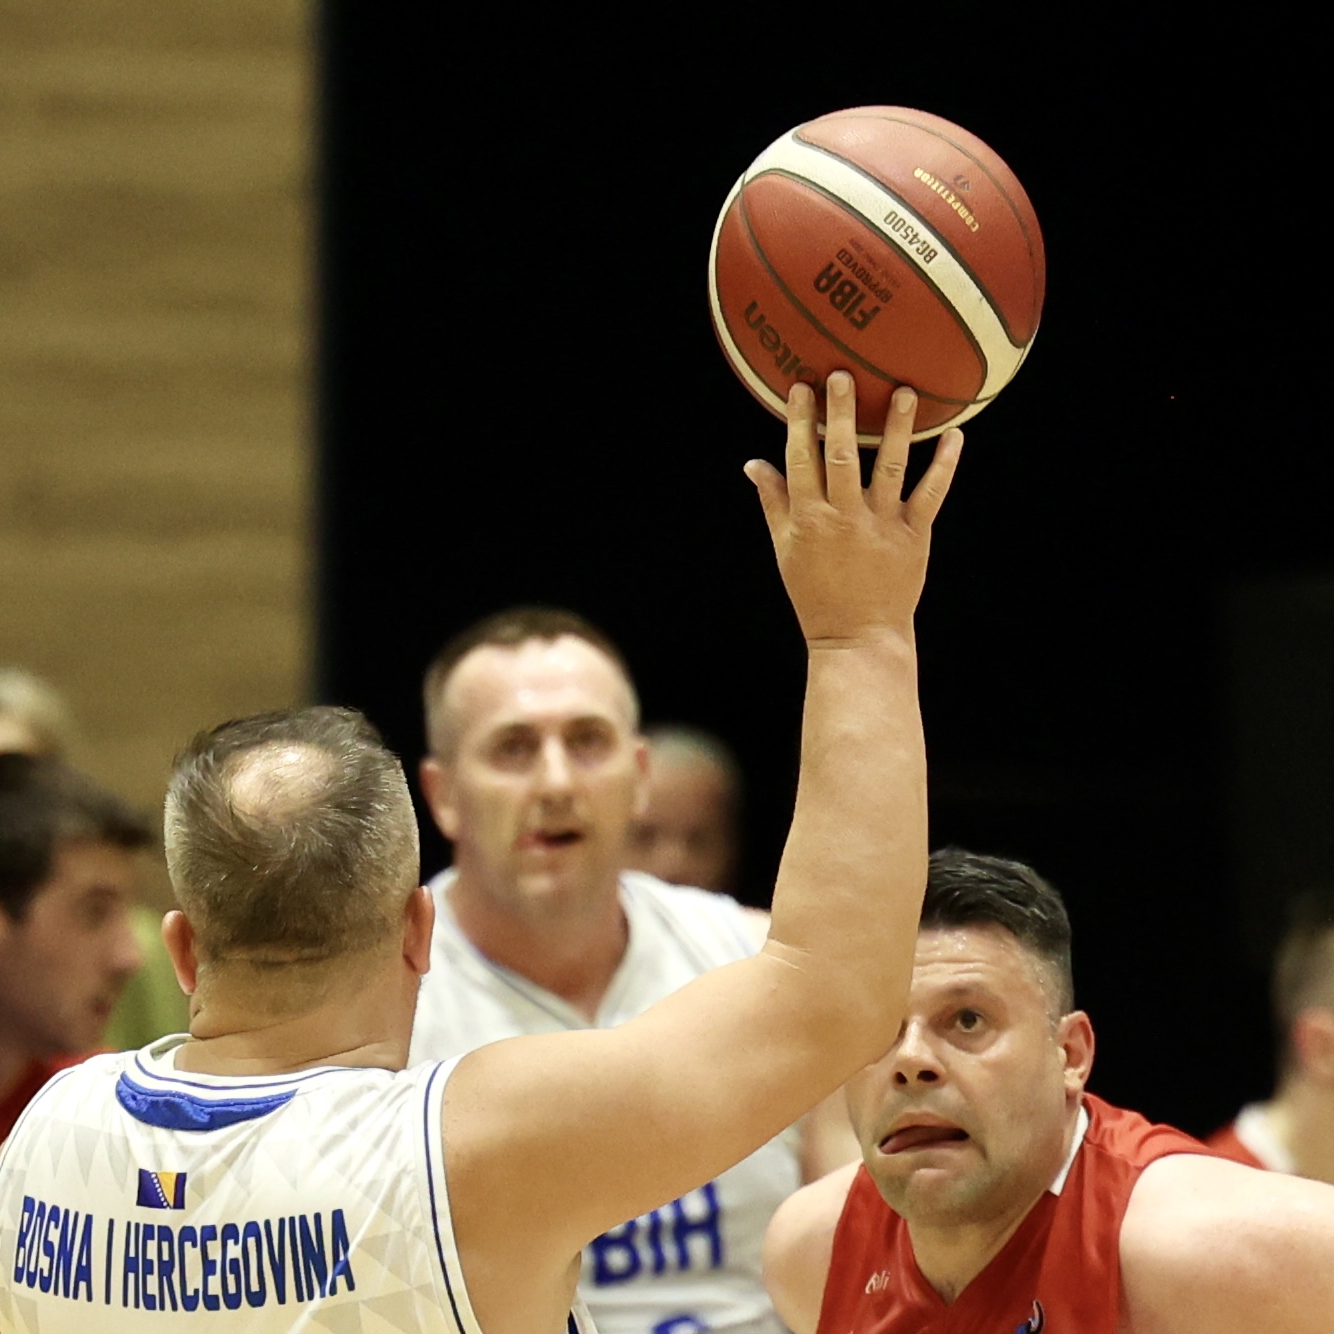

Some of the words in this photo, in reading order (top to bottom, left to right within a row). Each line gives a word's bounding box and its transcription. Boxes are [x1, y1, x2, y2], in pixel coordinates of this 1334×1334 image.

[913, 167, 979, 233] COMPETITION
[883, 210, 939, 265] BG4500
[813, 262, 882, 331] FIBA
[836, 248, 893, 303] APPROVED
[744, 300, 827, 394] olten
[13, 1194, 93, 1303] BOSNA
[104, 1217, 115, 1305] I
[122, 1208, 356, 1313] HERCEGOVINA
